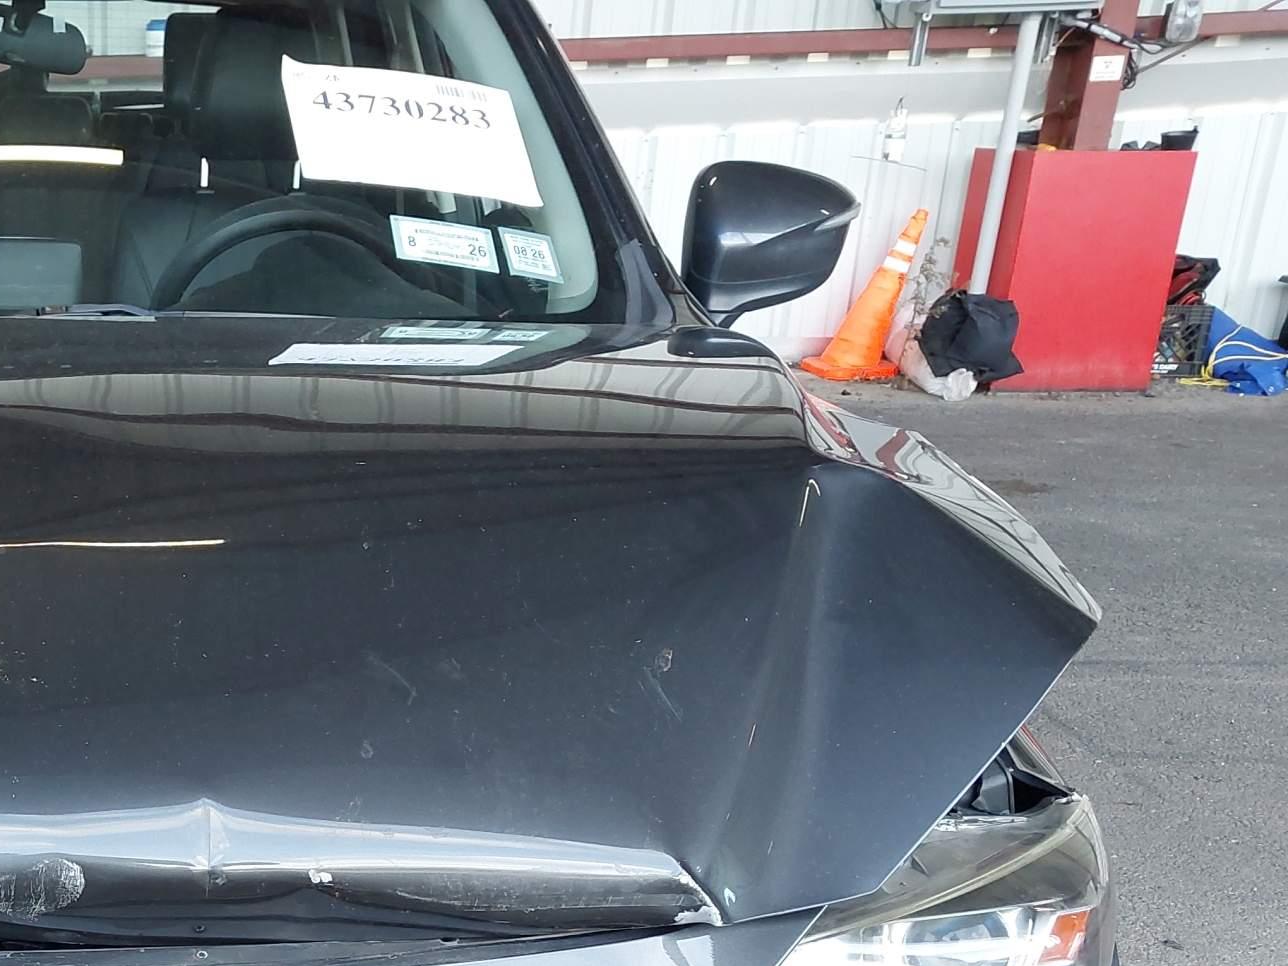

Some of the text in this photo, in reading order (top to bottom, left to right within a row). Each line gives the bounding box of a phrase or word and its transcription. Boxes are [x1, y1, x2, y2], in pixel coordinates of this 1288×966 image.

[312, 90, 491, 129] 43730283
[407, 235, 417, 247] 8
[467, 243, 487, 258] 26
[513, 244, 545, 260] 08 26
